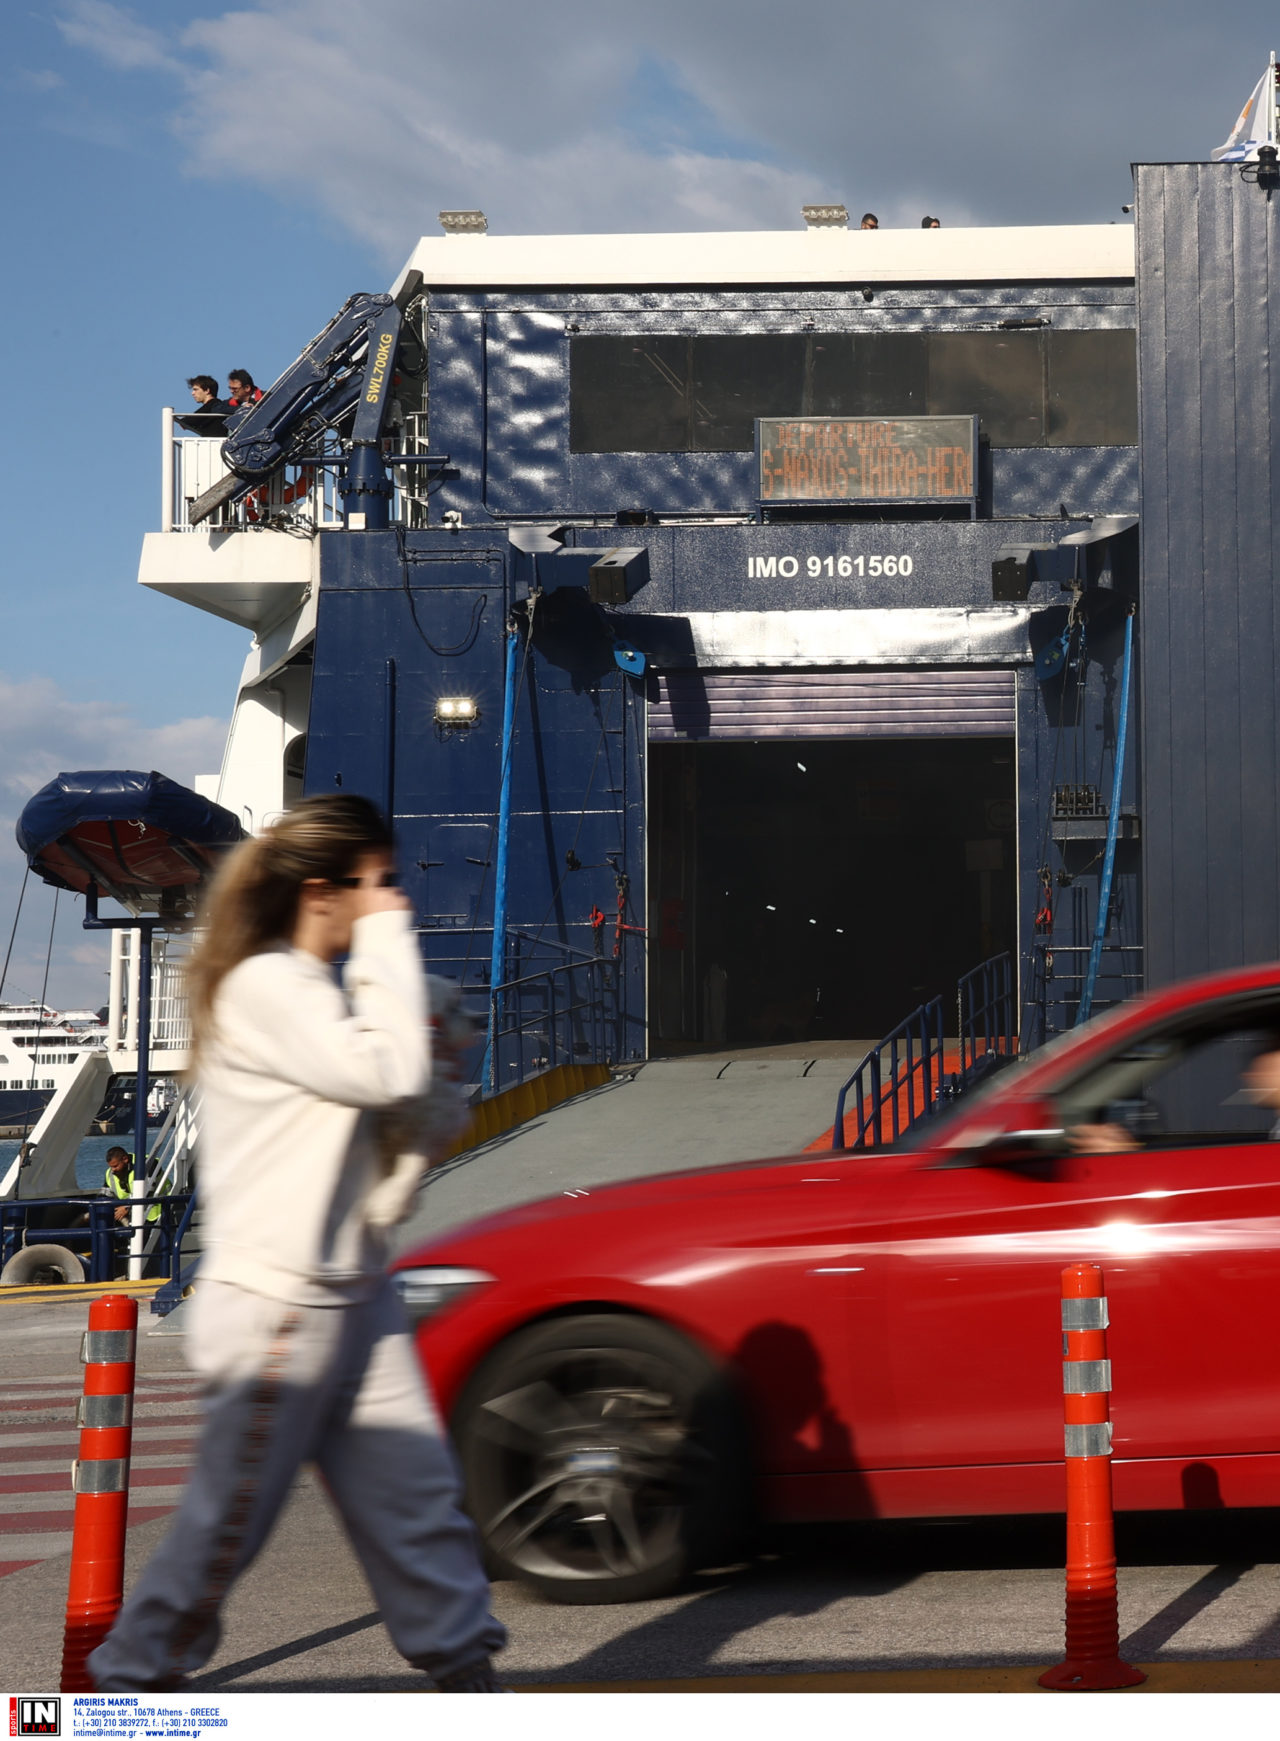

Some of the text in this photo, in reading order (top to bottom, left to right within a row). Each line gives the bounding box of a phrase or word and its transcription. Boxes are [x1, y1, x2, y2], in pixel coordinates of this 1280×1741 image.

[366, 333, 393, 403] SWL700KG
[748, 555, 913, 578] IMO 9161560
